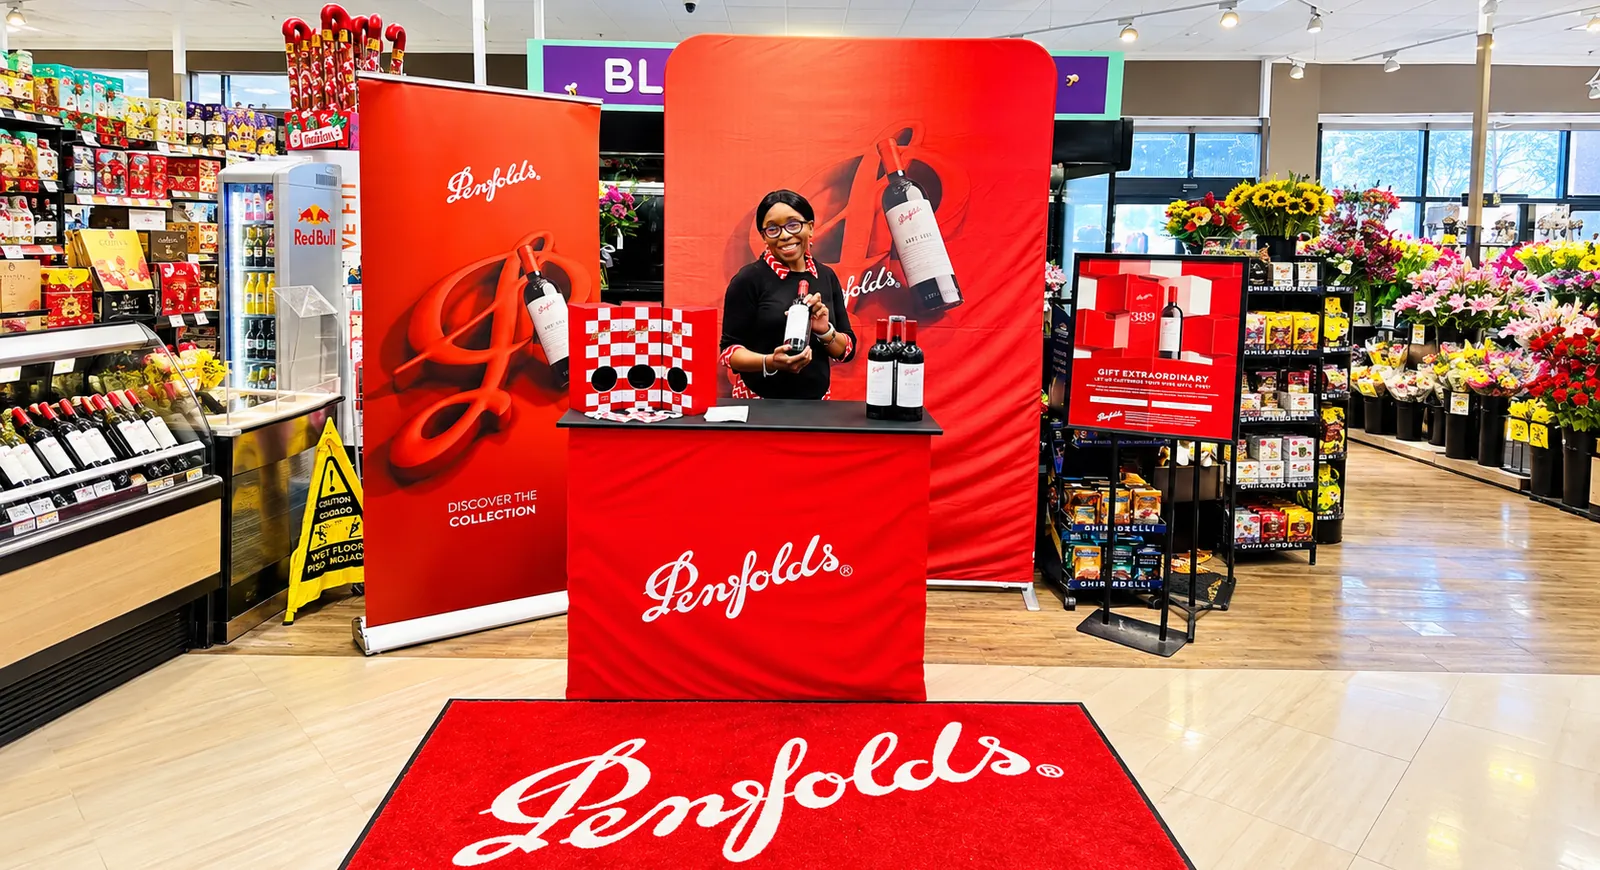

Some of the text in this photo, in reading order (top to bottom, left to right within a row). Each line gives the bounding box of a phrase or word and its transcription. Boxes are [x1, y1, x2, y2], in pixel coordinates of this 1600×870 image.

[1130, 311, 1156, 323] 389
[1097, 368, 1121, 377] GIFT
[1122, 369, 1210, 384] EXTRAORDINARY
[448, 489, 538, 514] DISCOVER THE
[449, 504, 537, 527] COLLECTION
[311, 547, 330, 562] WET
